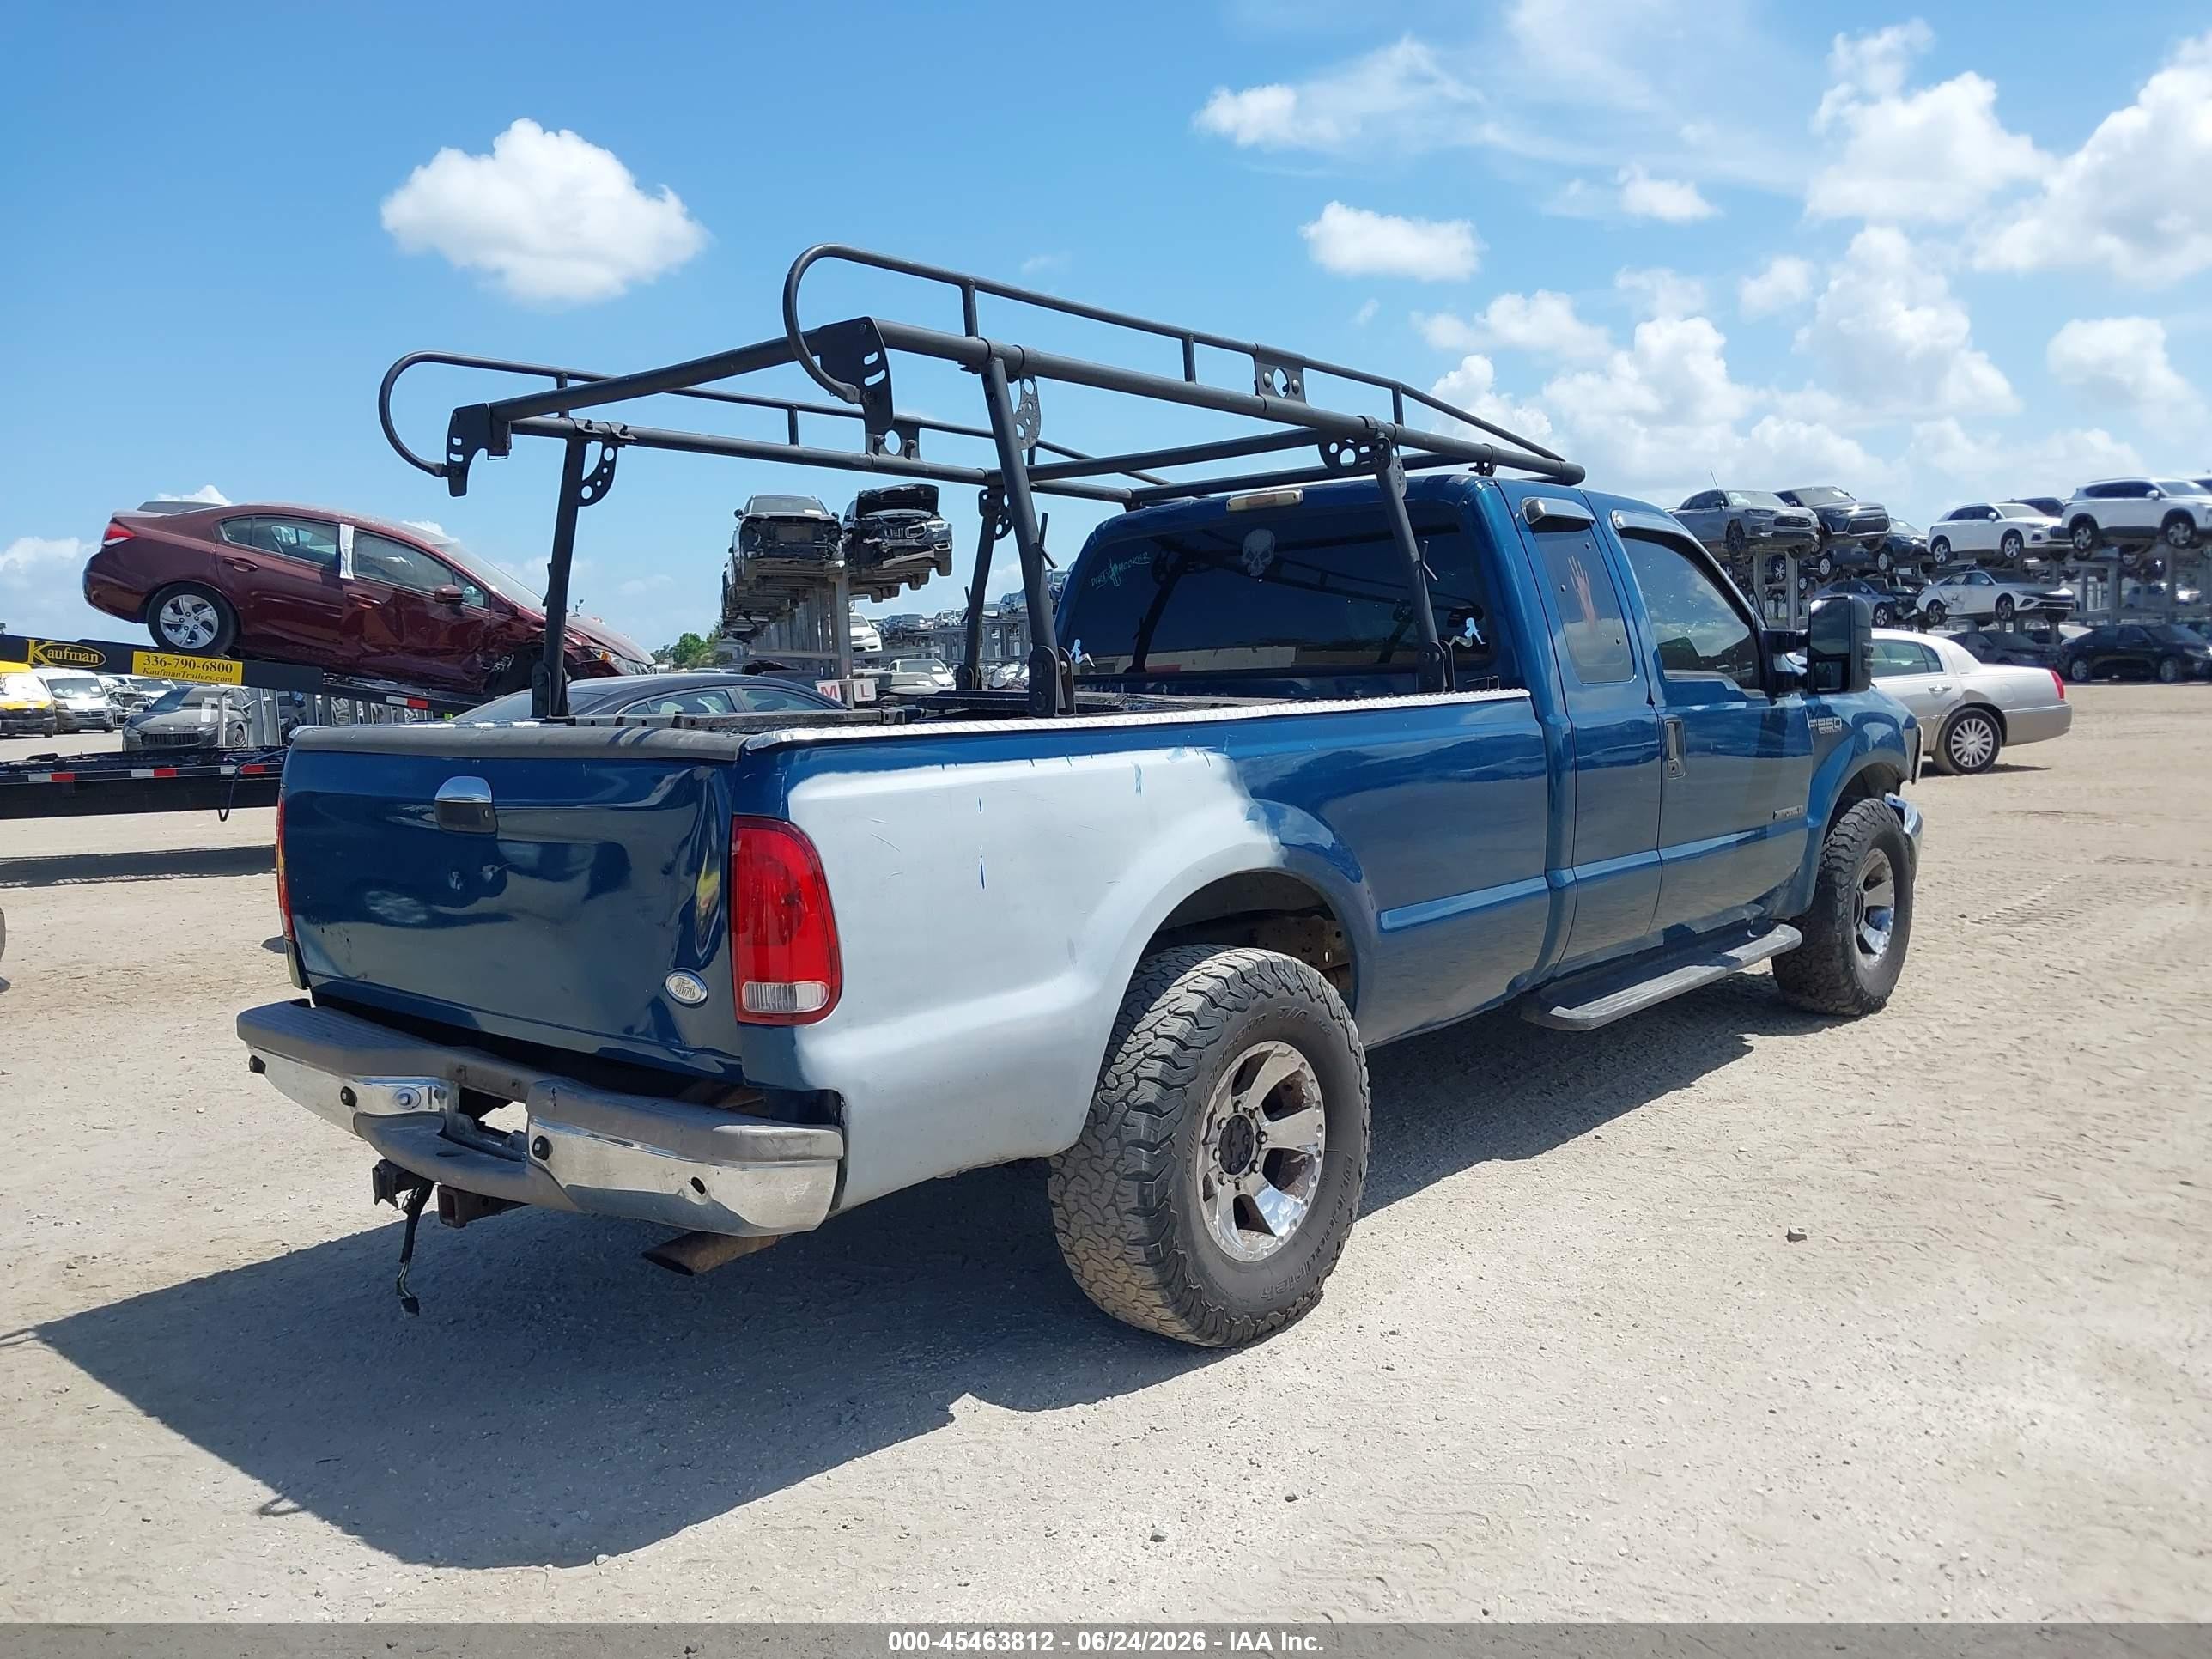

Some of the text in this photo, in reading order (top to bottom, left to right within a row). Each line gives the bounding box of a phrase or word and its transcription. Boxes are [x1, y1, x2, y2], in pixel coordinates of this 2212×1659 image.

[27, 639, 99, 666] Kaufman
[143, 655, 233, 674] 336-790-6800
[143, 667, 233, 683] KaufmanTrailers.com
[860, 684, 871, 697] L
